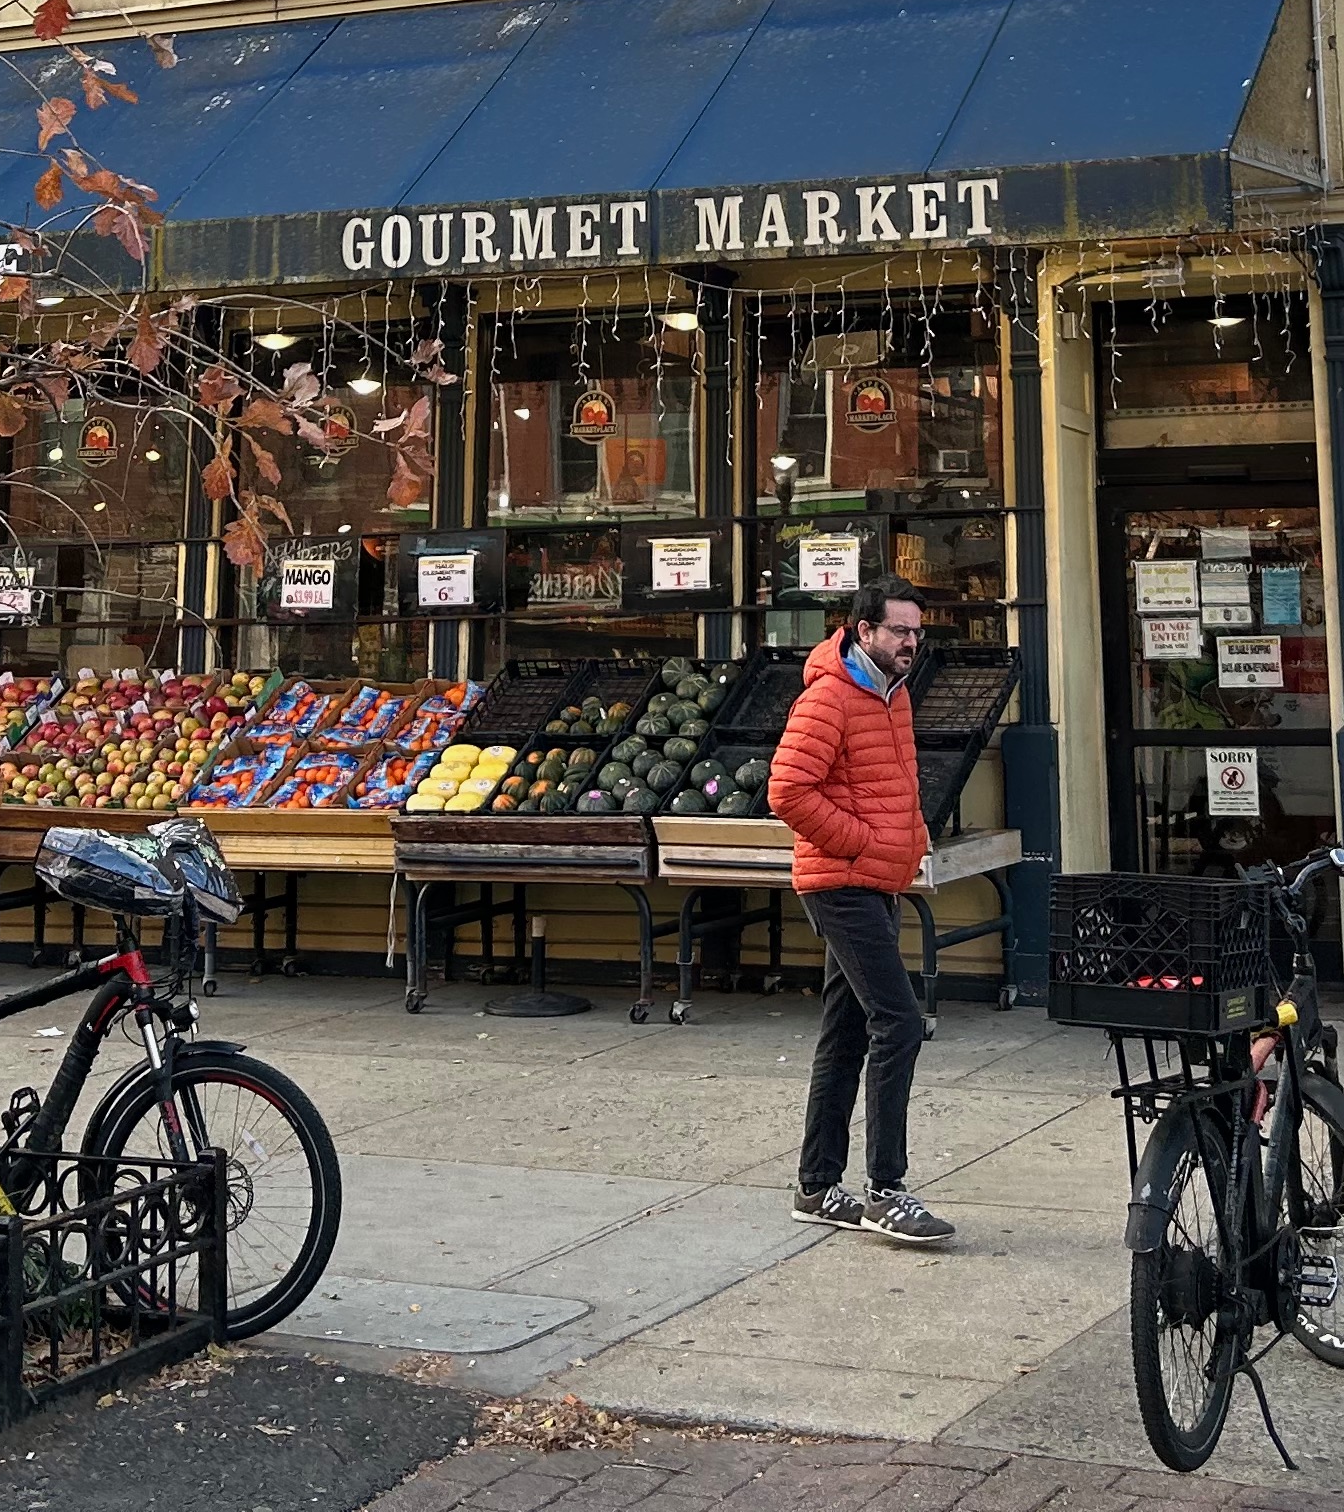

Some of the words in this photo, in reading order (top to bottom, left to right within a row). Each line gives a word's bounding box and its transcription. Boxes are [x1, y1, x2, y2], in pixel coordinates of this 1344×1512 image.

[341, 199, 646, 271] GOURMET
[695, 178, 999, 253] MARKET
[285, 568, 331, 586] MANGO
[1149, 622, 1166, 632] DO
[1209, 751, 1253, 764] SORRY
